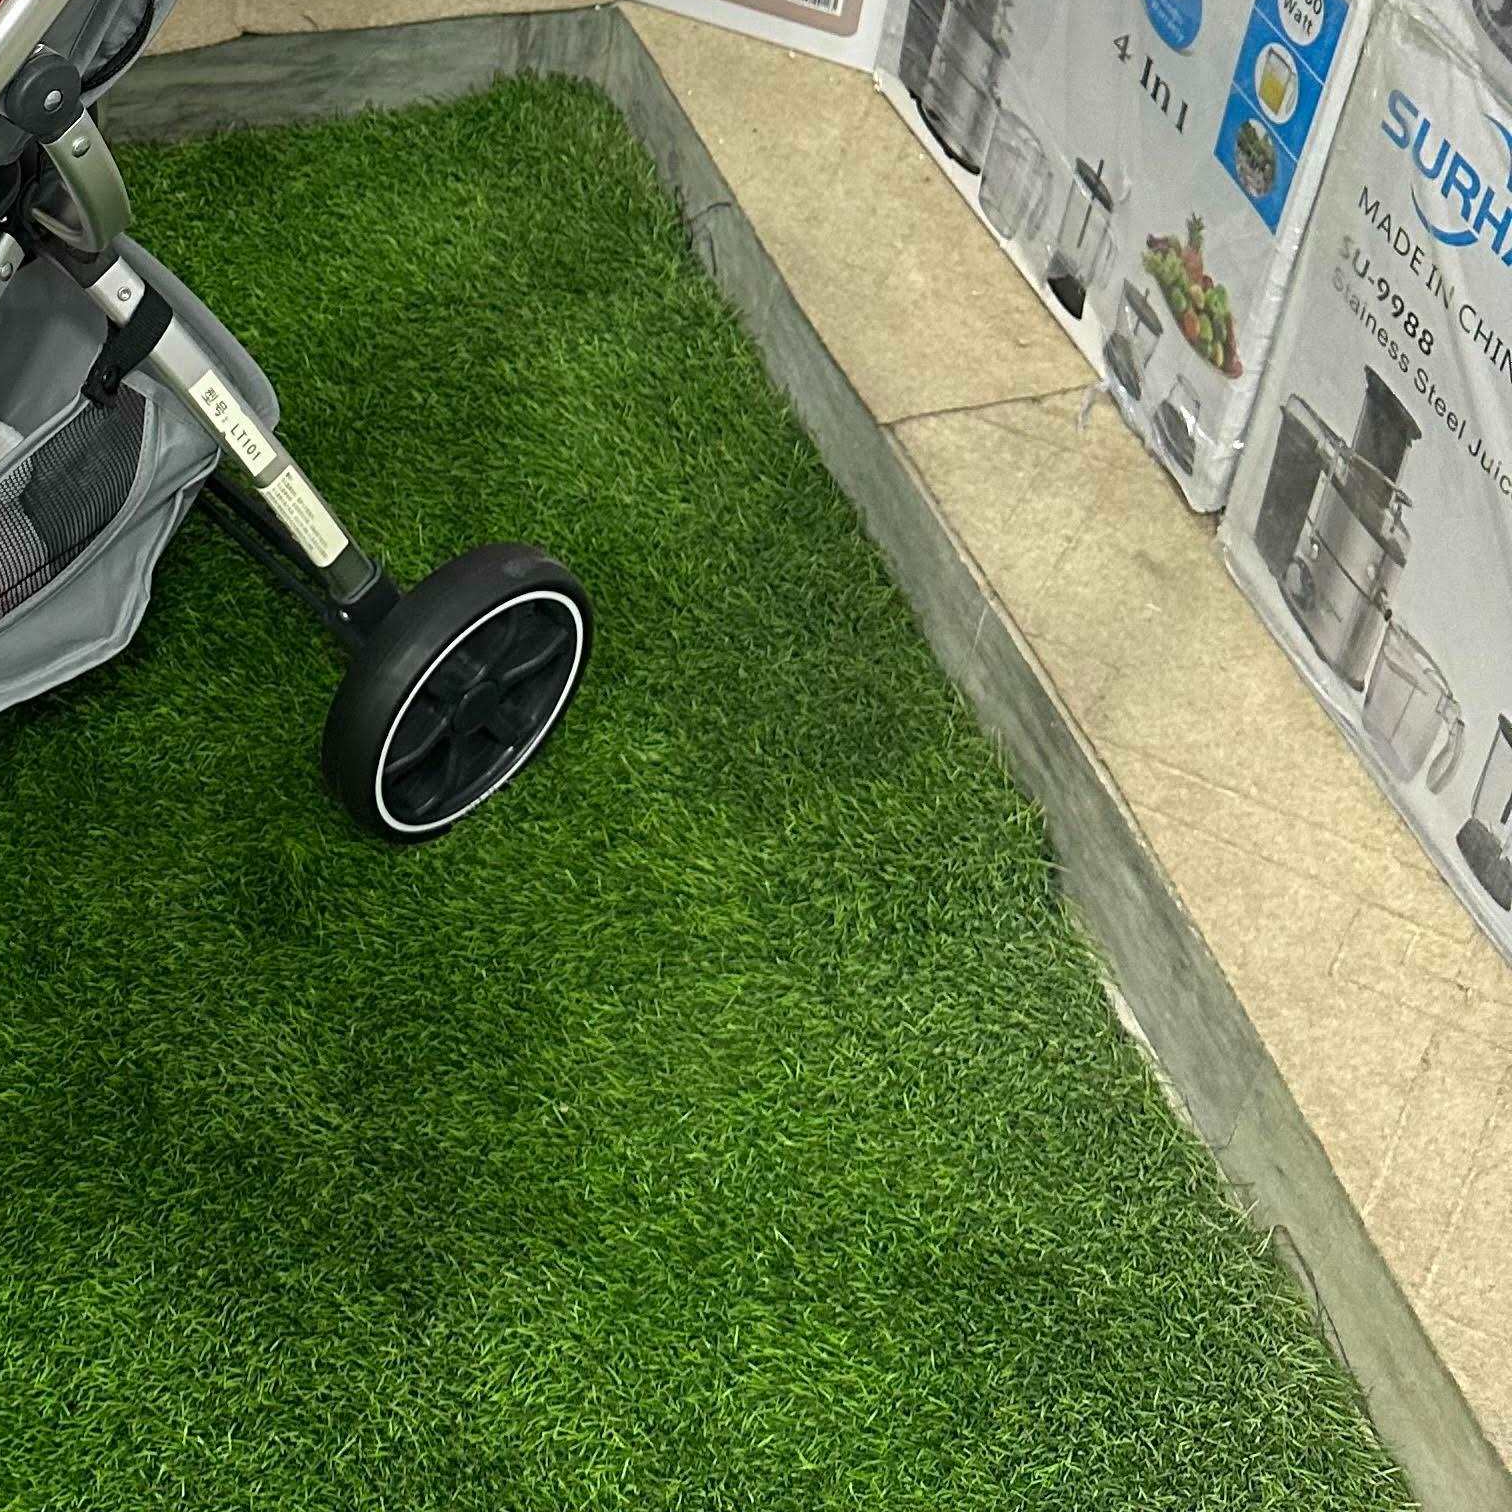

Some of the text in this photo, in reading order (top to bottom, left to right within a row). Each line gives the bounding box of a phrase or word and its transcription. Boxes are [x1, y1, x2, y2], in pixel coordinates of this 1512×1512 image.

[1112, 32, 1131, 64] 4
[1380, 88, 1512, 268] SURH
[1339, 234, 1436, 357] SU-9988
[1357, 184, 1425, 278] MADE
[1425, 262, 1456, 311] IN
[229, 423, 262, 462] LT101
[1414, 367, 1467, 440] Steel
